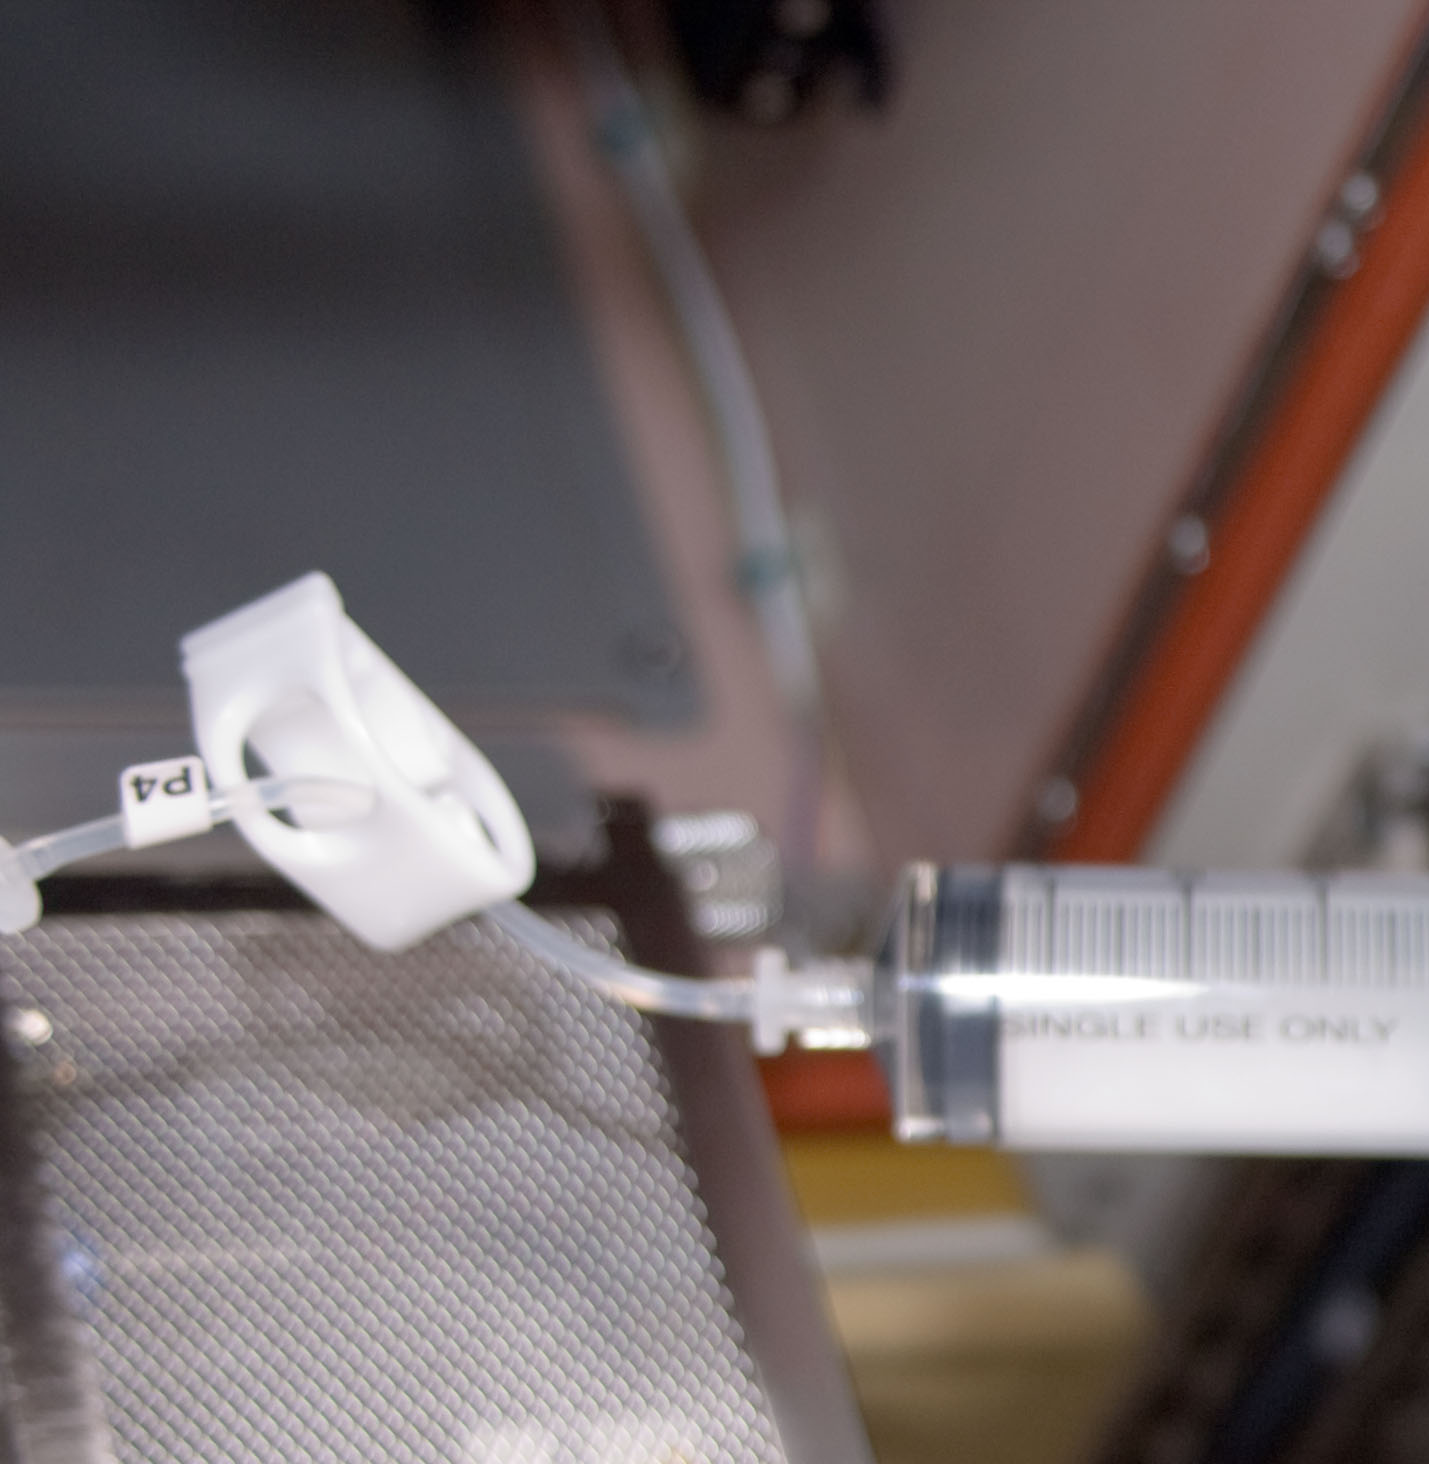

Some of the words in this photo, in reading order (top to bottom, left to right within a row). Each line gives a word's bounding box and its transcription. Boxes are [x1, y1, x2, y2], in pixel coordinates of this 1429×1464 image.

[131, 766, 193, 803] P4
[1001, 1011, 1158, 1042] SINGLE
[1174, 1012, 1266, 1043] USE
[1279, 1013, 1397, 1045] ONLY
